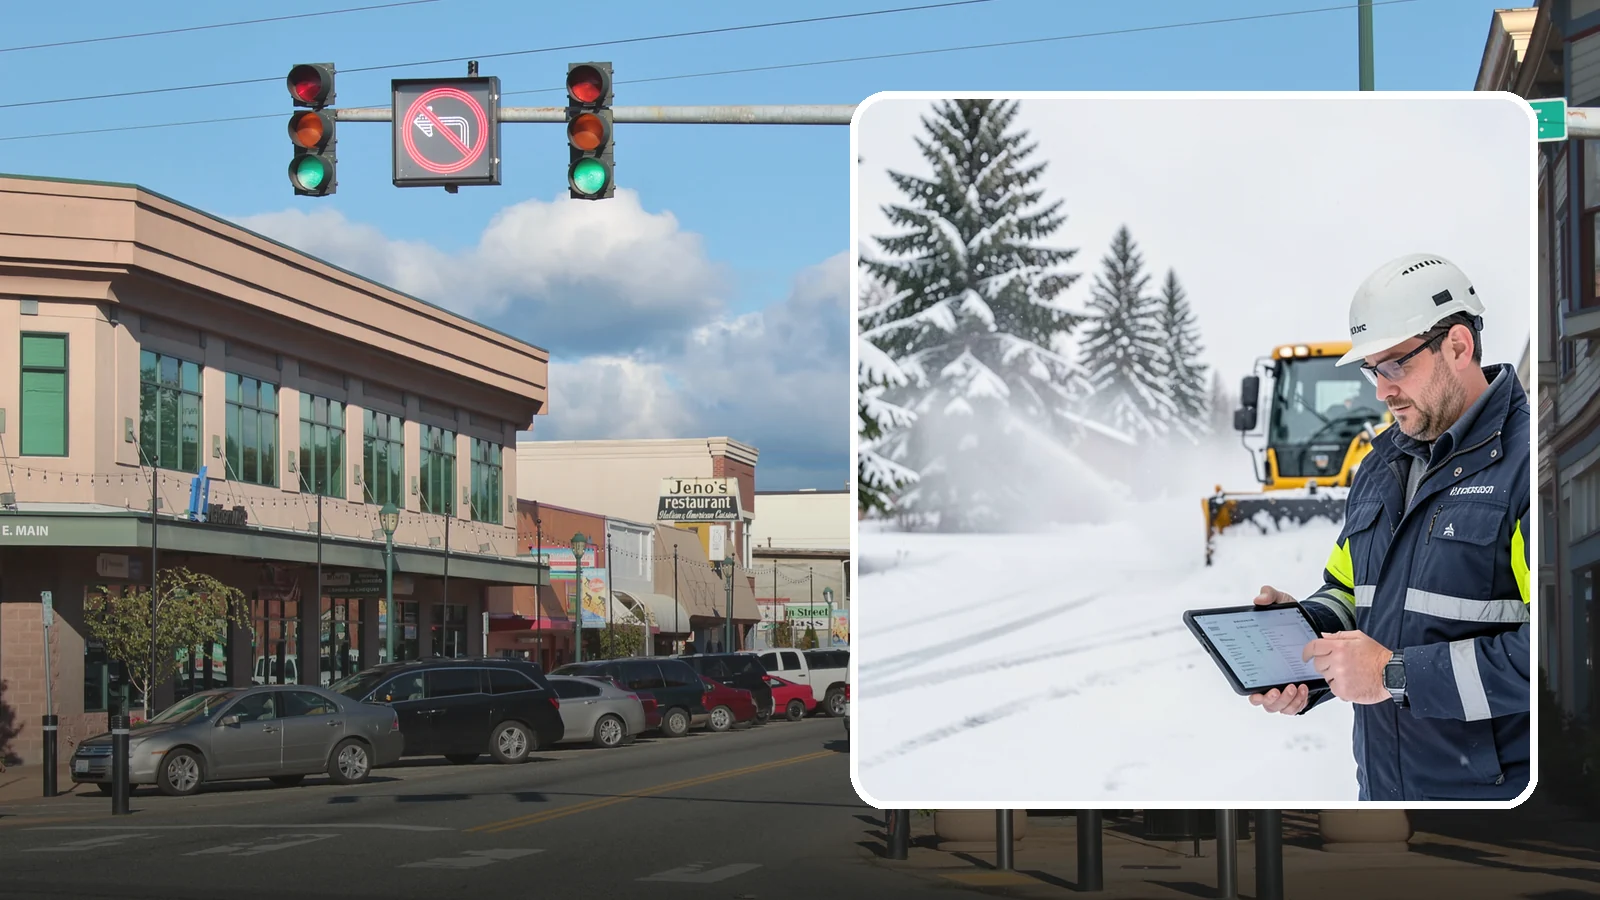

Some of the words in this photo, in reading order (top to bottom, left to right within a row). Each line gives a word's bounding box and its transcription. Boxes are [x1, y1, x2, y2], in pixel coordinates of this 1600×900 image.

[670, 480, 727, 494] Jeno's
[665, 497, 731, 509] restaurant
[659, 510, 681, 519] Italian
[686, 510, 714, 519] American
[715, 510, 737, 519] Cuisine
[2, 525, 13, 536] E.
[15, 525, 49, 536] MAIN
[797, 608, 828, 617] Street
